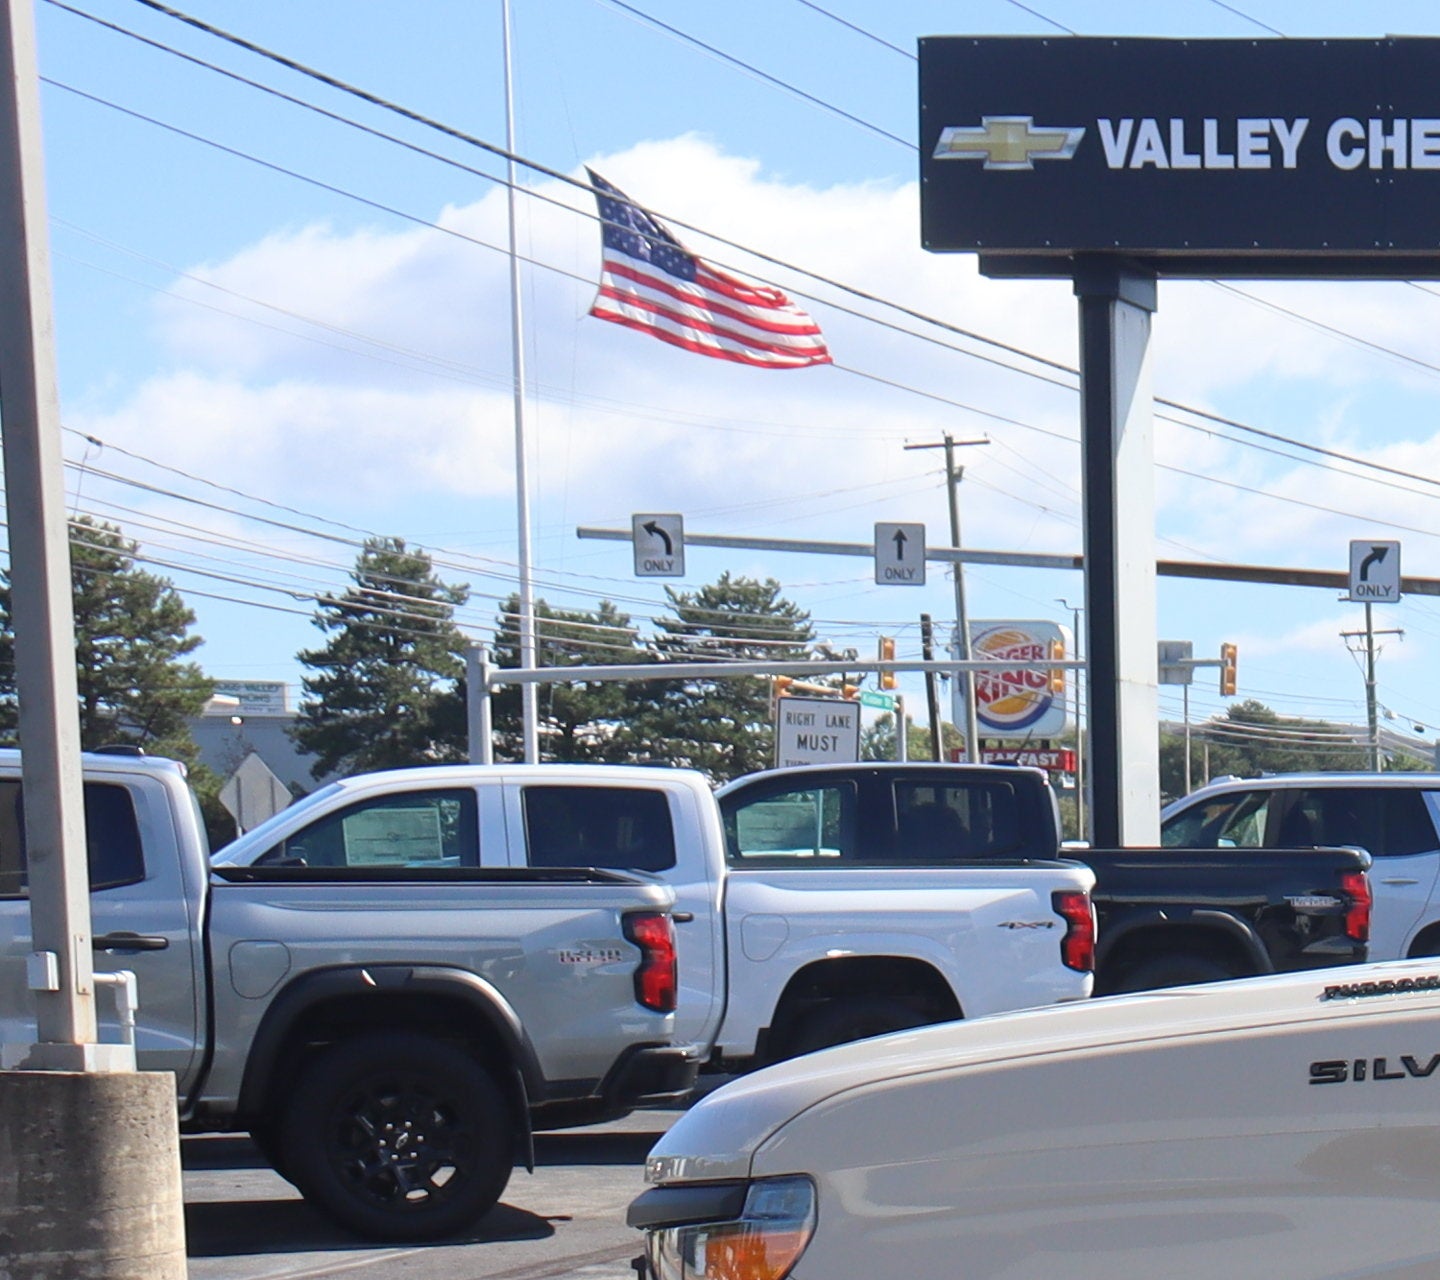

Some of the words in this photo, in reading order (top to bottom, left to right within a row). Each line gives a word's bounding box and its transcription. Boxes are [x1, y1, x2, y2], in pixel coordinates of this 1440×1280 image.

[1098, 117, 1311, 170] VALLEY
[643, 559, 675, 572] ONLY
[884, 567, 917, 580] ONLY
[1356, 584, 1392, 597] ONLY
[786, 712, 815, 726] RIGHT
[825, 714, 851, 729] LANE
[796, 734, 839, 752] MUST
